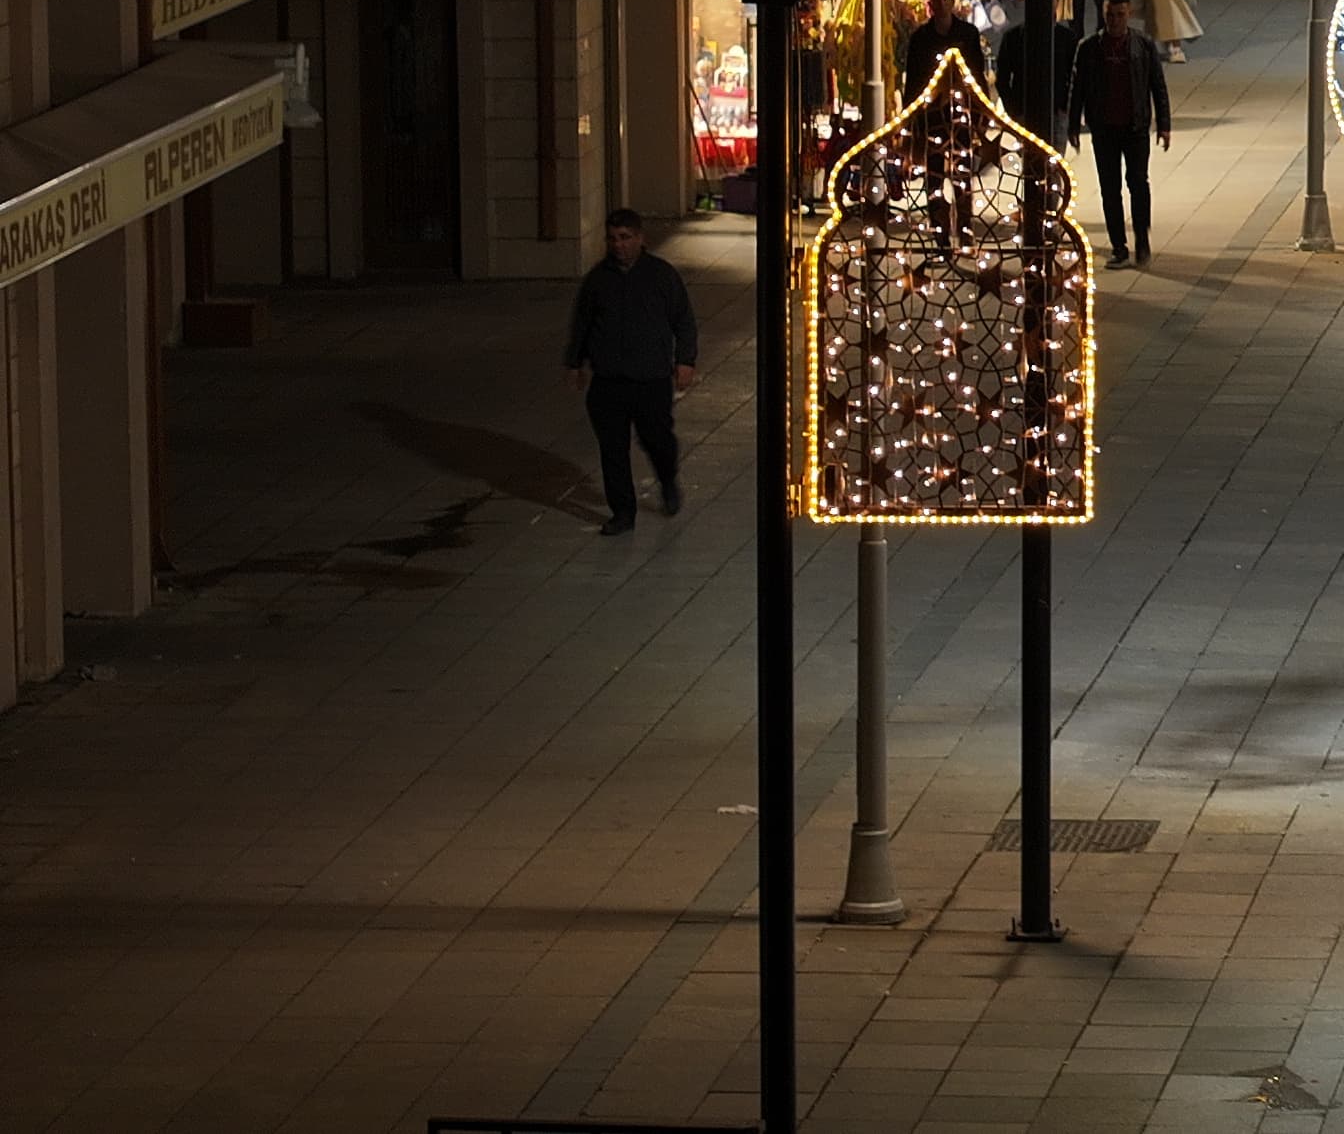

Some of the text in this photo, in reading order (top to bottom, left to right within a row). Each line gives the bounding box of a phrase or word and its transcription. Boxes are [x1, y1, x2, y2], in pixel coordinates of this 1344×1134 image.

[144, 118, 225, 200] ALPEREN
[0, 168, 107, 271] ARAKAŞ DERİ
